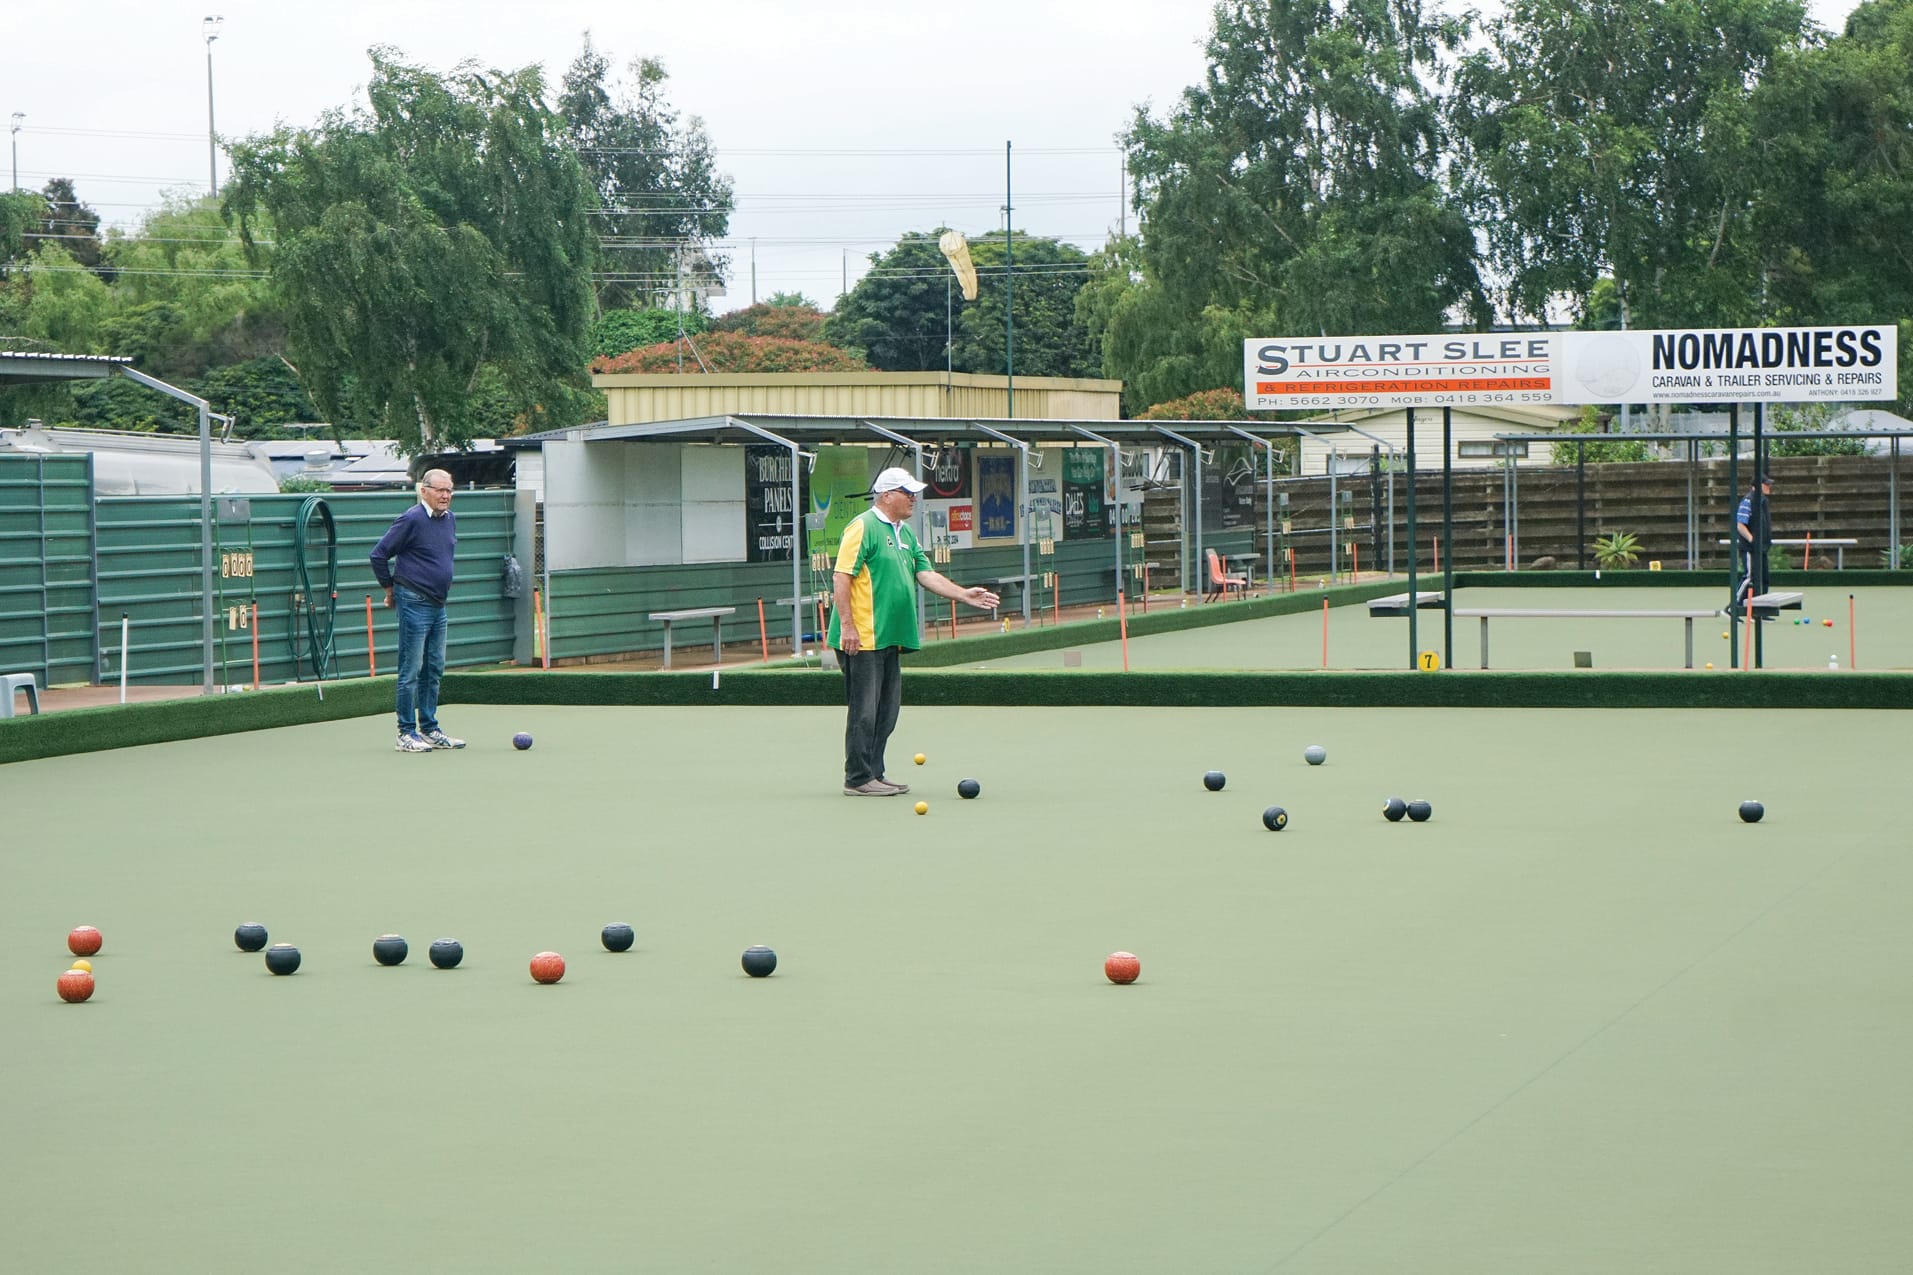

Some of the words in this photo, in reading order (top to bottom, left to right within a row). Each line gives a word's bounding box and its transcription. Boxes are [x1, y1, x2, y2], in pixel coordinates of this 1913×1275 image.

[1257, 342, 1428, 375] STUART
[1443, 339, 1549, 360] SLEE
[1652, 329, 1882, 370] NOMADNESS
[1296, 365, 1550, 378] AIRCONDITIONING
[1264, 384, 1275, 392] &
[1285, 382, 1449, 392] REFRIGERATION
[1457, 379, 1546, 390] REPAIRS
[1652, 375, 1701, 388] CARAVAN
[1704, 375, 1713, 387] &
[1718, 374, 1761, 387] TRAILER
[1764, 373, 1821, 386] SERVICING
[1824, 373, 1833, 385] &
[1837, 372, 1882, 385] REPAIRS
[1290, 396, 1332, 406] 5662
[1337, 395, 1380, 405] 3070
[1391, 396, 1428, 404] MOB:
[1434, 394, 1477, 404] 0418
[1483, 393, 1515, 402] 364
[1521, 392, 1553, 402] 559
[1652, 390, 1782, 399] www.nomadnesscaravanrepairs.com.au
[759, 455, 793, 482] BURCHEL
[764, 487, 793, 513] PANELS
[1424, 654, 1433, 669] 7
